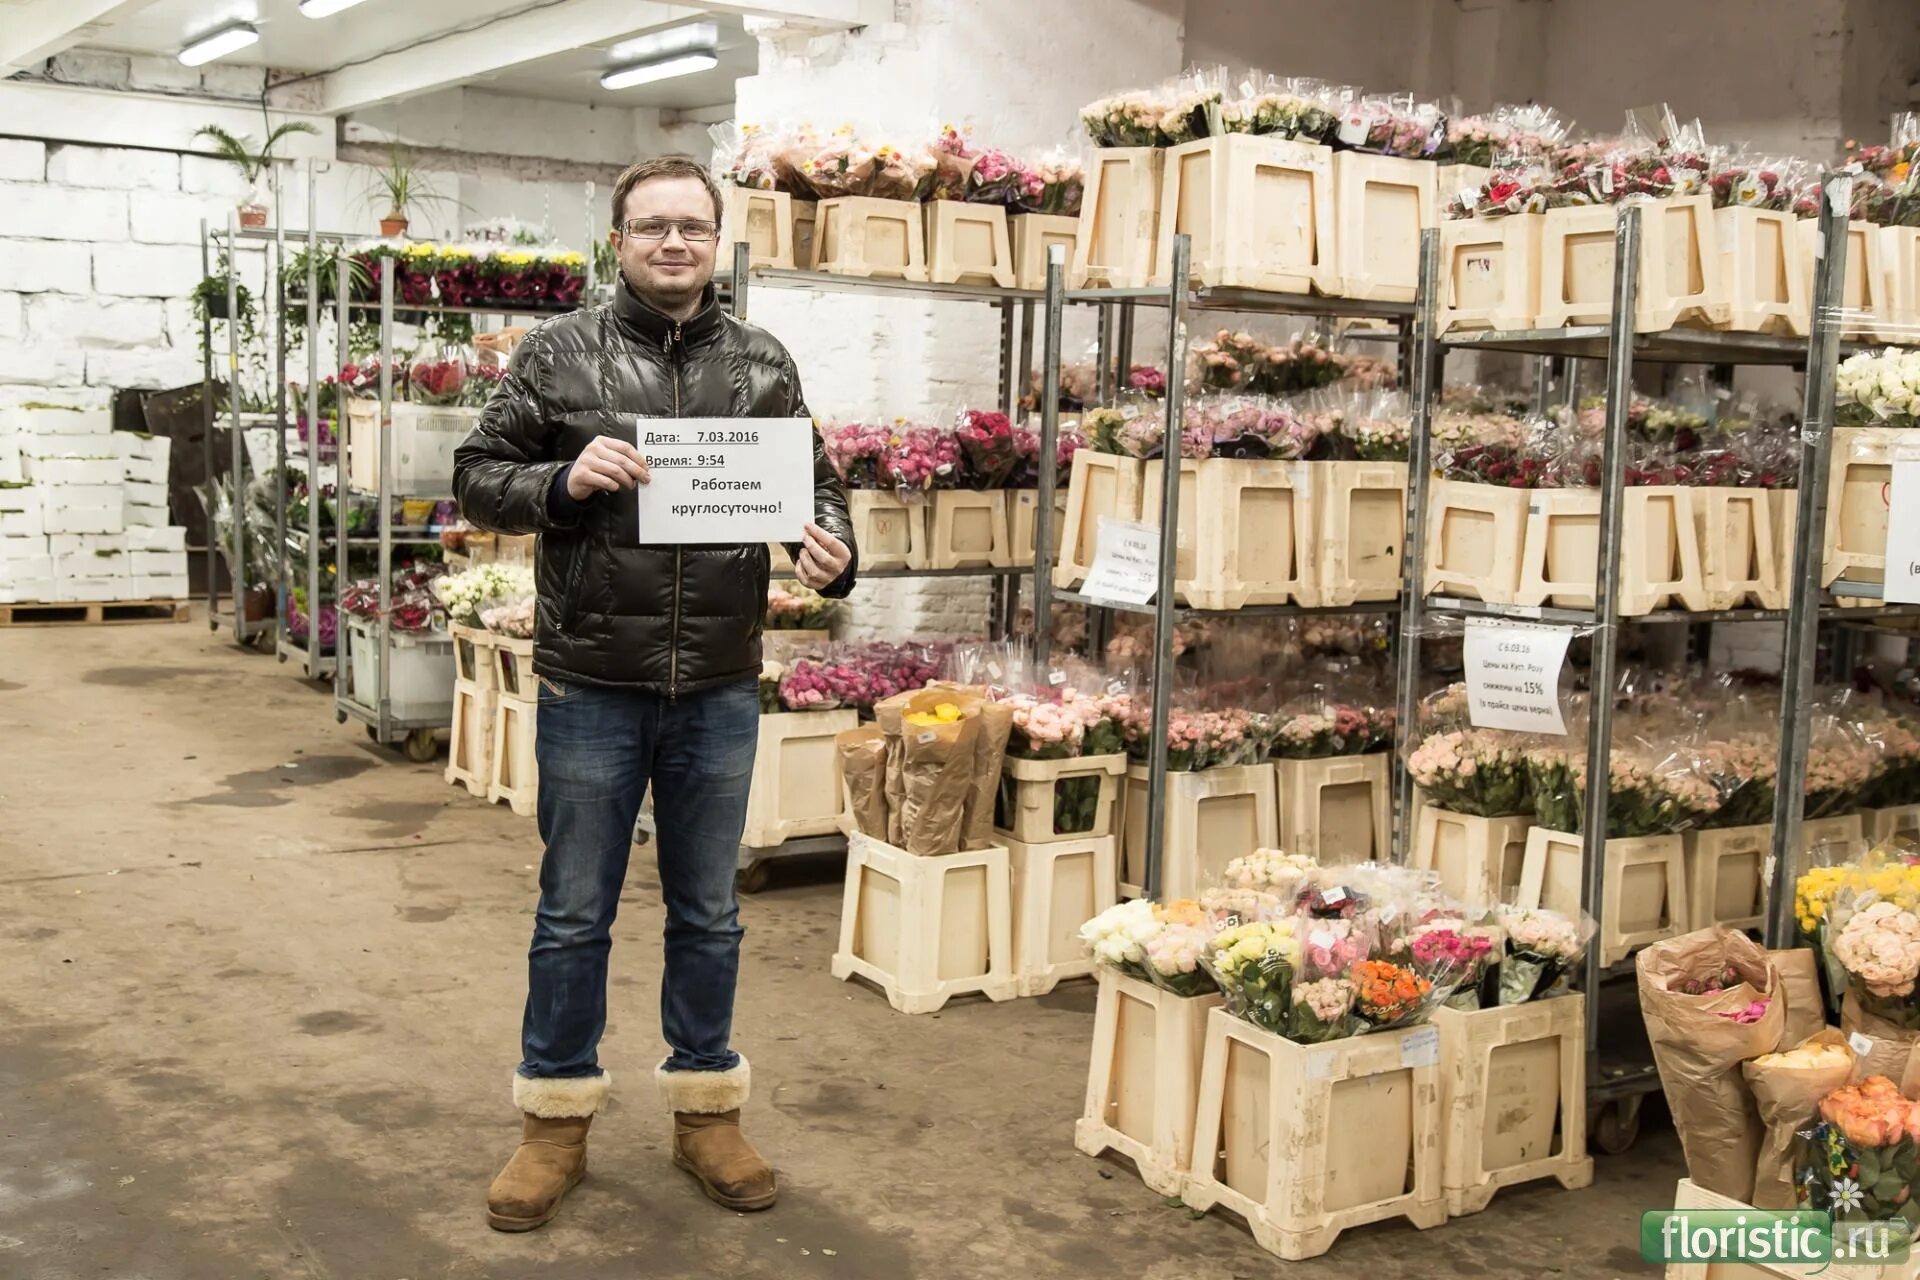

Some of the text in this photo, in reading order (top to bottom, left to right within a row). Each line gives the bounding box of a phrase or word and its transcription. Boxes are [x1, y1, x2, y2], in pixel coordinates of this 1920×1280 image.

[645, 431, 759, 445] Дата: 7.03.2016
[645, 455, 725, 467] Время: 9:54
[692, 478, 762, 490] Работаем
[672, 501, 782, 516] круглосуточно!
[1524, 681, 1544, 695] 15%
